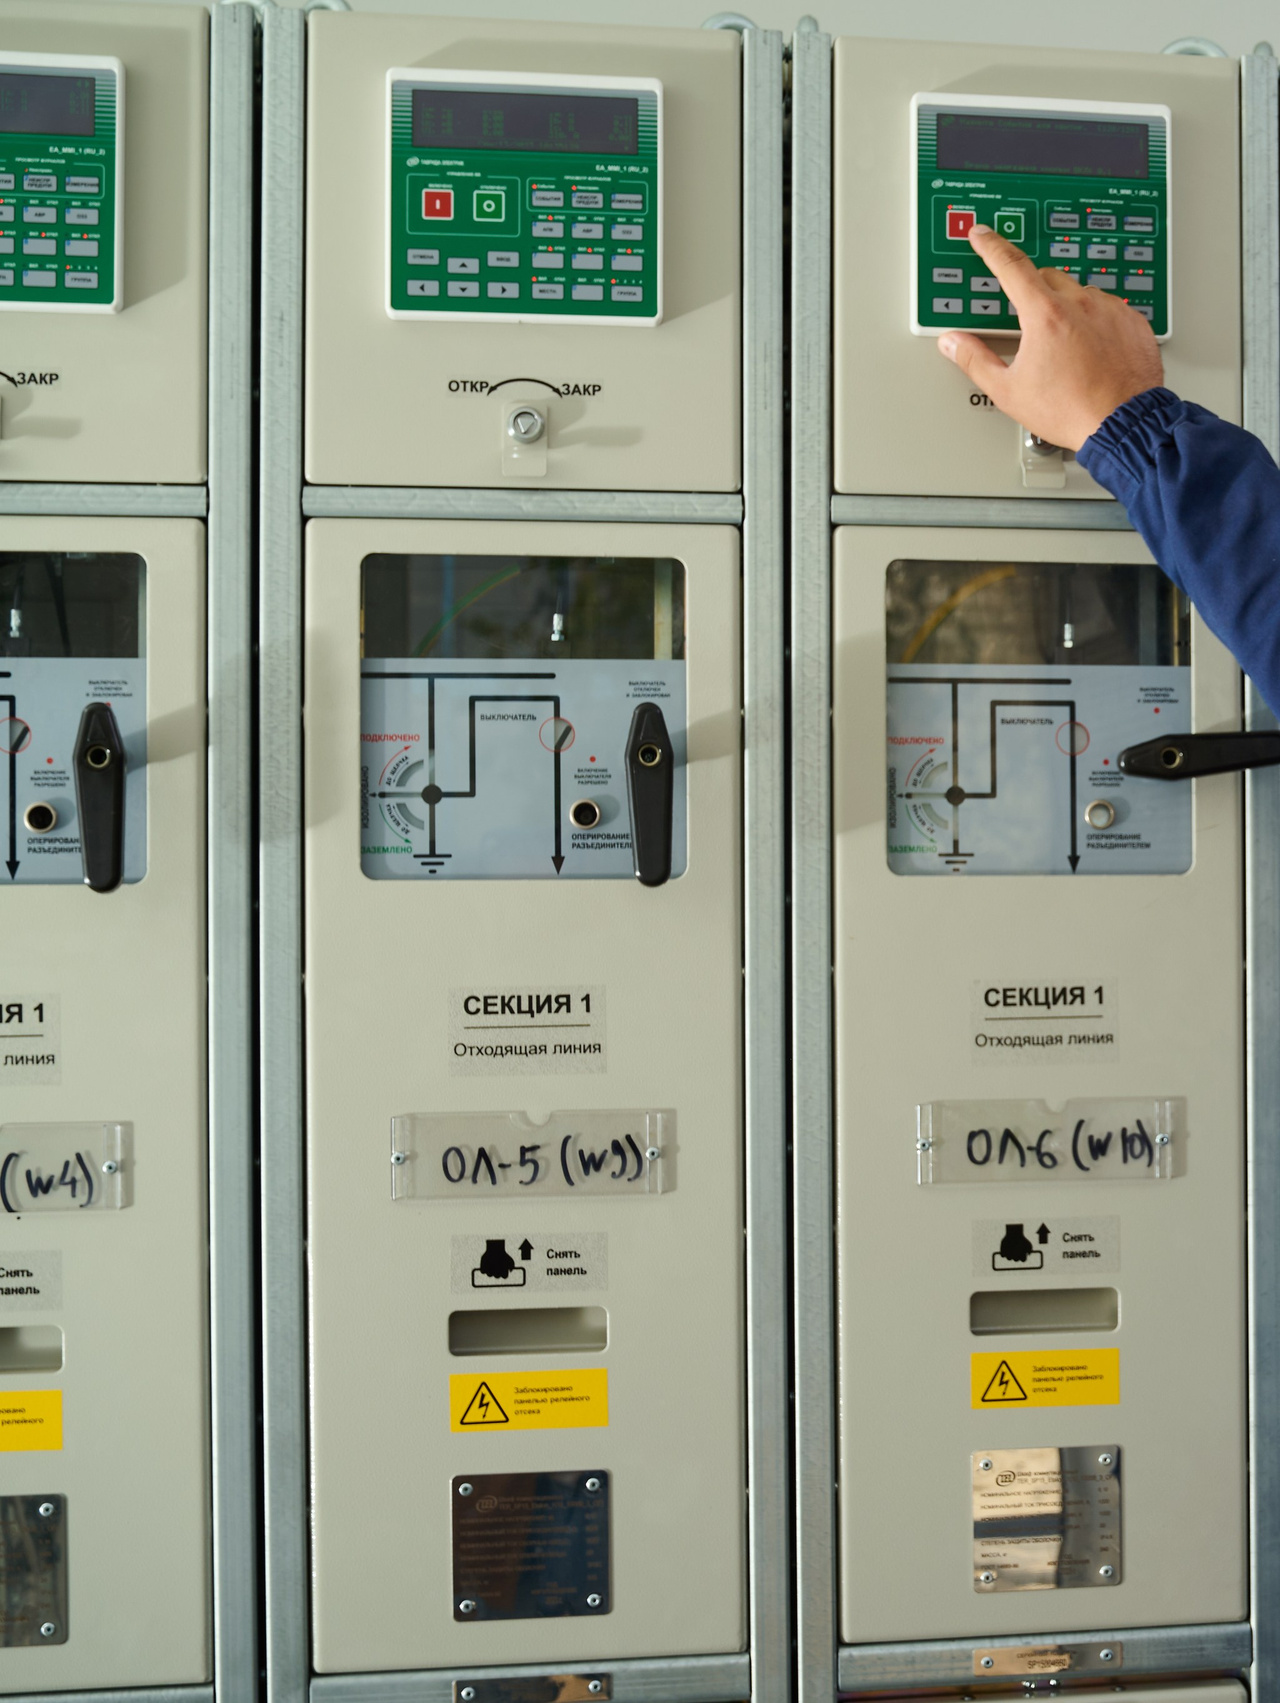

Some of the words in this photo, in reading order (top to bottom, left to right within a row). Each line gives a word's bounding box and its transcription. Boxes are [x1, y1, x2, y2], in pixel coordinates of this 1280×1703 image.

[17, 372, 59, 385] ЗАКР
[448, 380, 489, 393] ОТКР
[562, 384, 602, 396] ЗАКР
[480, 714, 537, 722] ВЫКЛЮЧАТЕЛЬ
[888, 736, 944, 745] ПОДКЛЮЧЕНО
[571, 833, 631, 841] ОПЕРИРОВАНИЕ
[1086, 833, 1141, 841] ОПЕРИРОВАНИЕ
[571, 842, 632, 850] РАЗЪЕДИНИТЕЛ
[1086, 842, 1151, 850] РАЗЪЕДИНИТЕЛЕМ
[984, 986, 1085, 1009] СЕКЦИЯ
[1094, 986, 1103, 1004] 1
[463, 994, 571, 1018] СЕКЦИЯ
[580, 993, 591, 1013] 1
[33, 1003, 44, 1023] 1
[975, 1033, 1063, 1048] Отходящая
[1068, 1032, 1114, 1045] линия
[453, 1042, 547, 1058] Отходящая
[552, 1042, 601, 1055] линия
[4, 1054, 55, 1066] линия
[1062, 1232, 1095, 1242] Снять
[546, 1249, 581, 1259] Снять
[1062, 1250, 1101, 1259] панель
[0, 1267, 33, 1278] Снять
[546, 1267, 587, 1276] панель
[514, 1385, 573, 1394] Заблокировано
[514, 1397, 548, 1405] панелью
[550, 1394, 590, 1404] релейного
